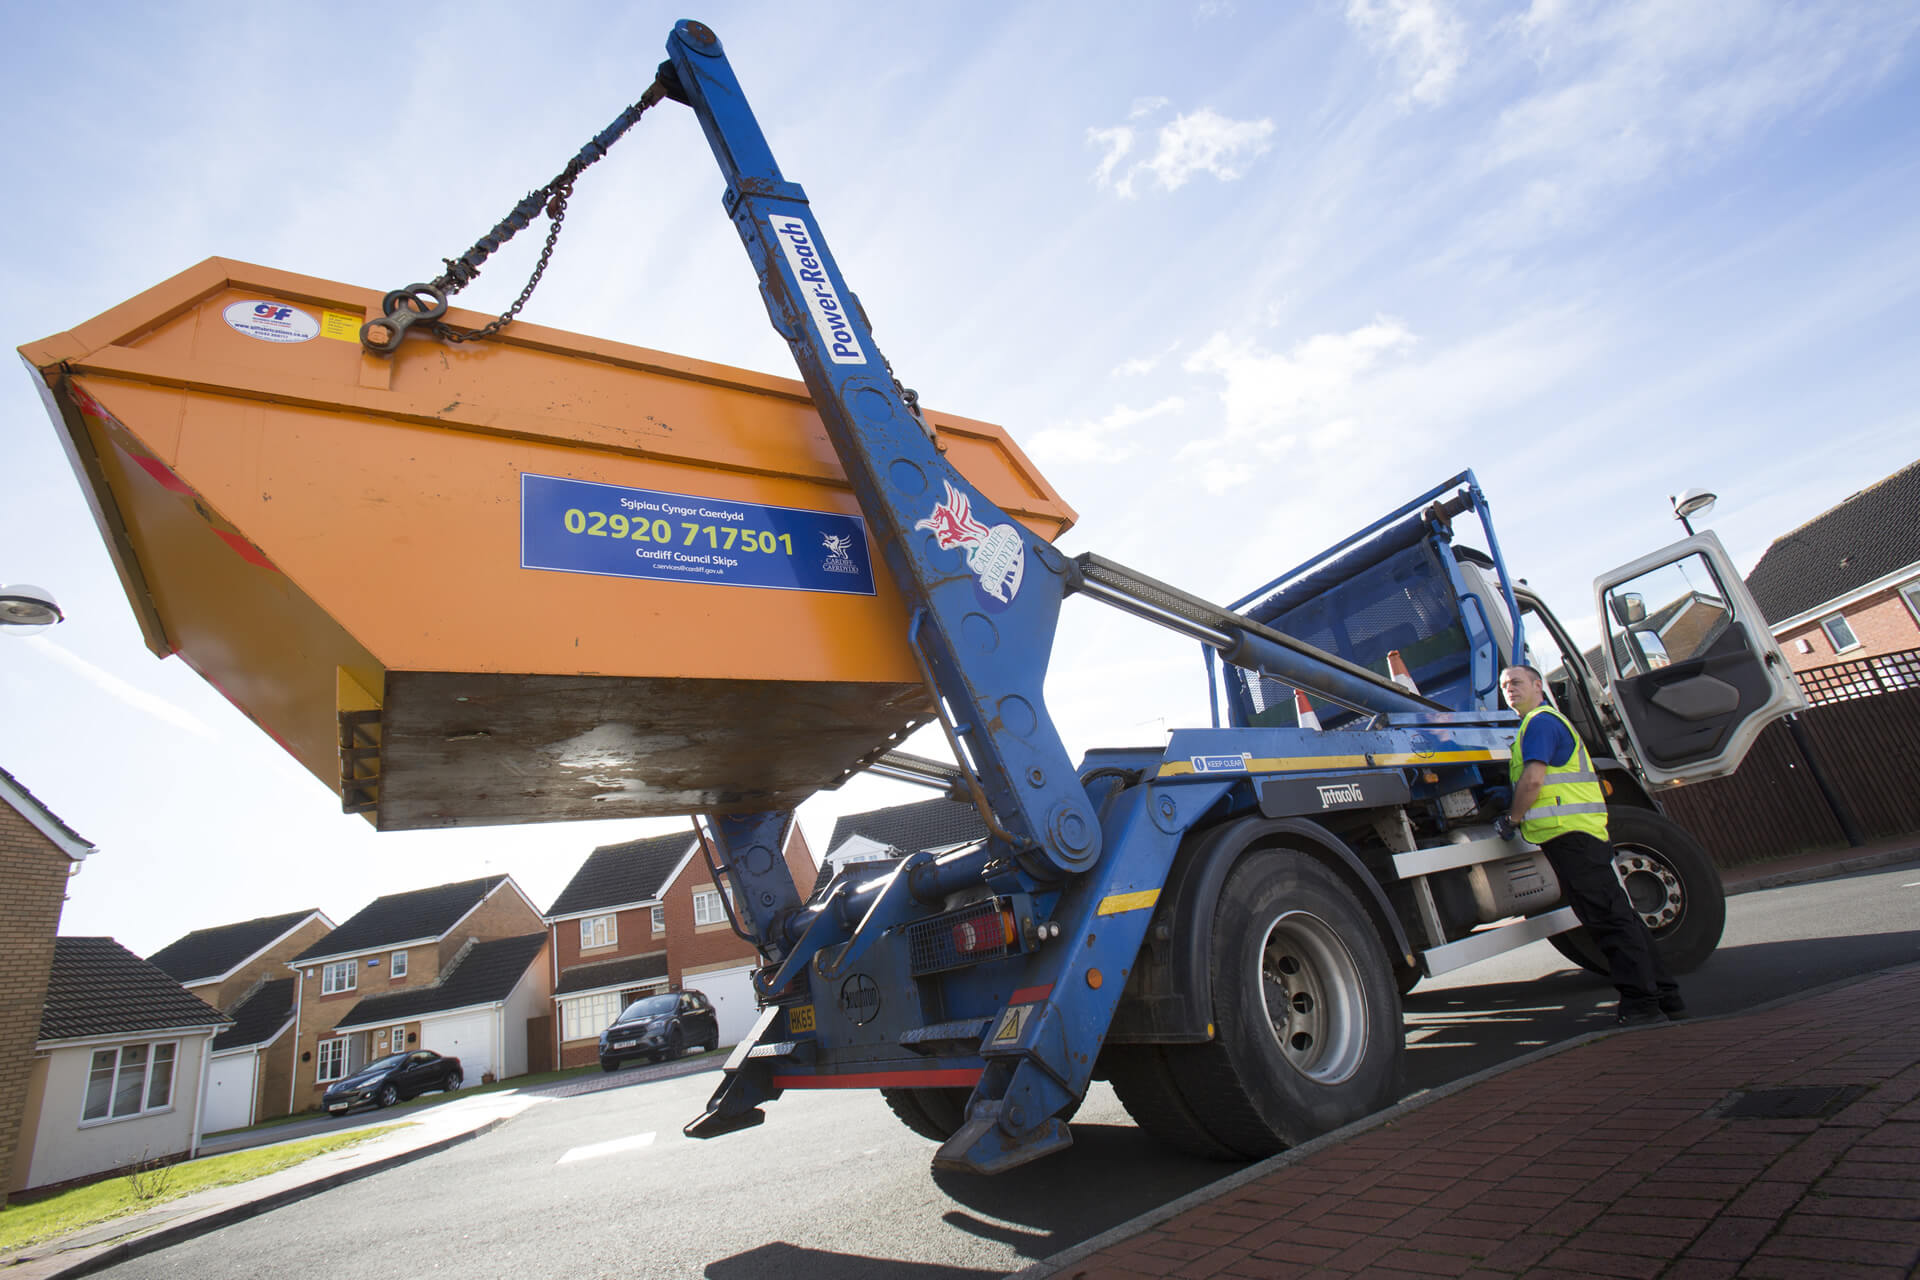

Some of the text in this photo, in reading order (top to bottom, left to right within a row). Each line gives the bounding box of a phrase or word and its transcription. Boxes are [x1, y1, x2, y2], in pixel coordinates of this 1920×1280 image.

[779, 223, 859, 357] Power-Reach
[564, 508, 793, 555] 02920 717501
[620, 497, 744, 521] Sgipiau Cyngor Caerdydd
[636, 548, 738, 568] Cardiff Council Skips
[973, 530, 1004, 575] CARDIFF
[983, 533, 1020, 591] CAERDYDD
[1207, 759, 1242, 768] KEEP CLEAR
